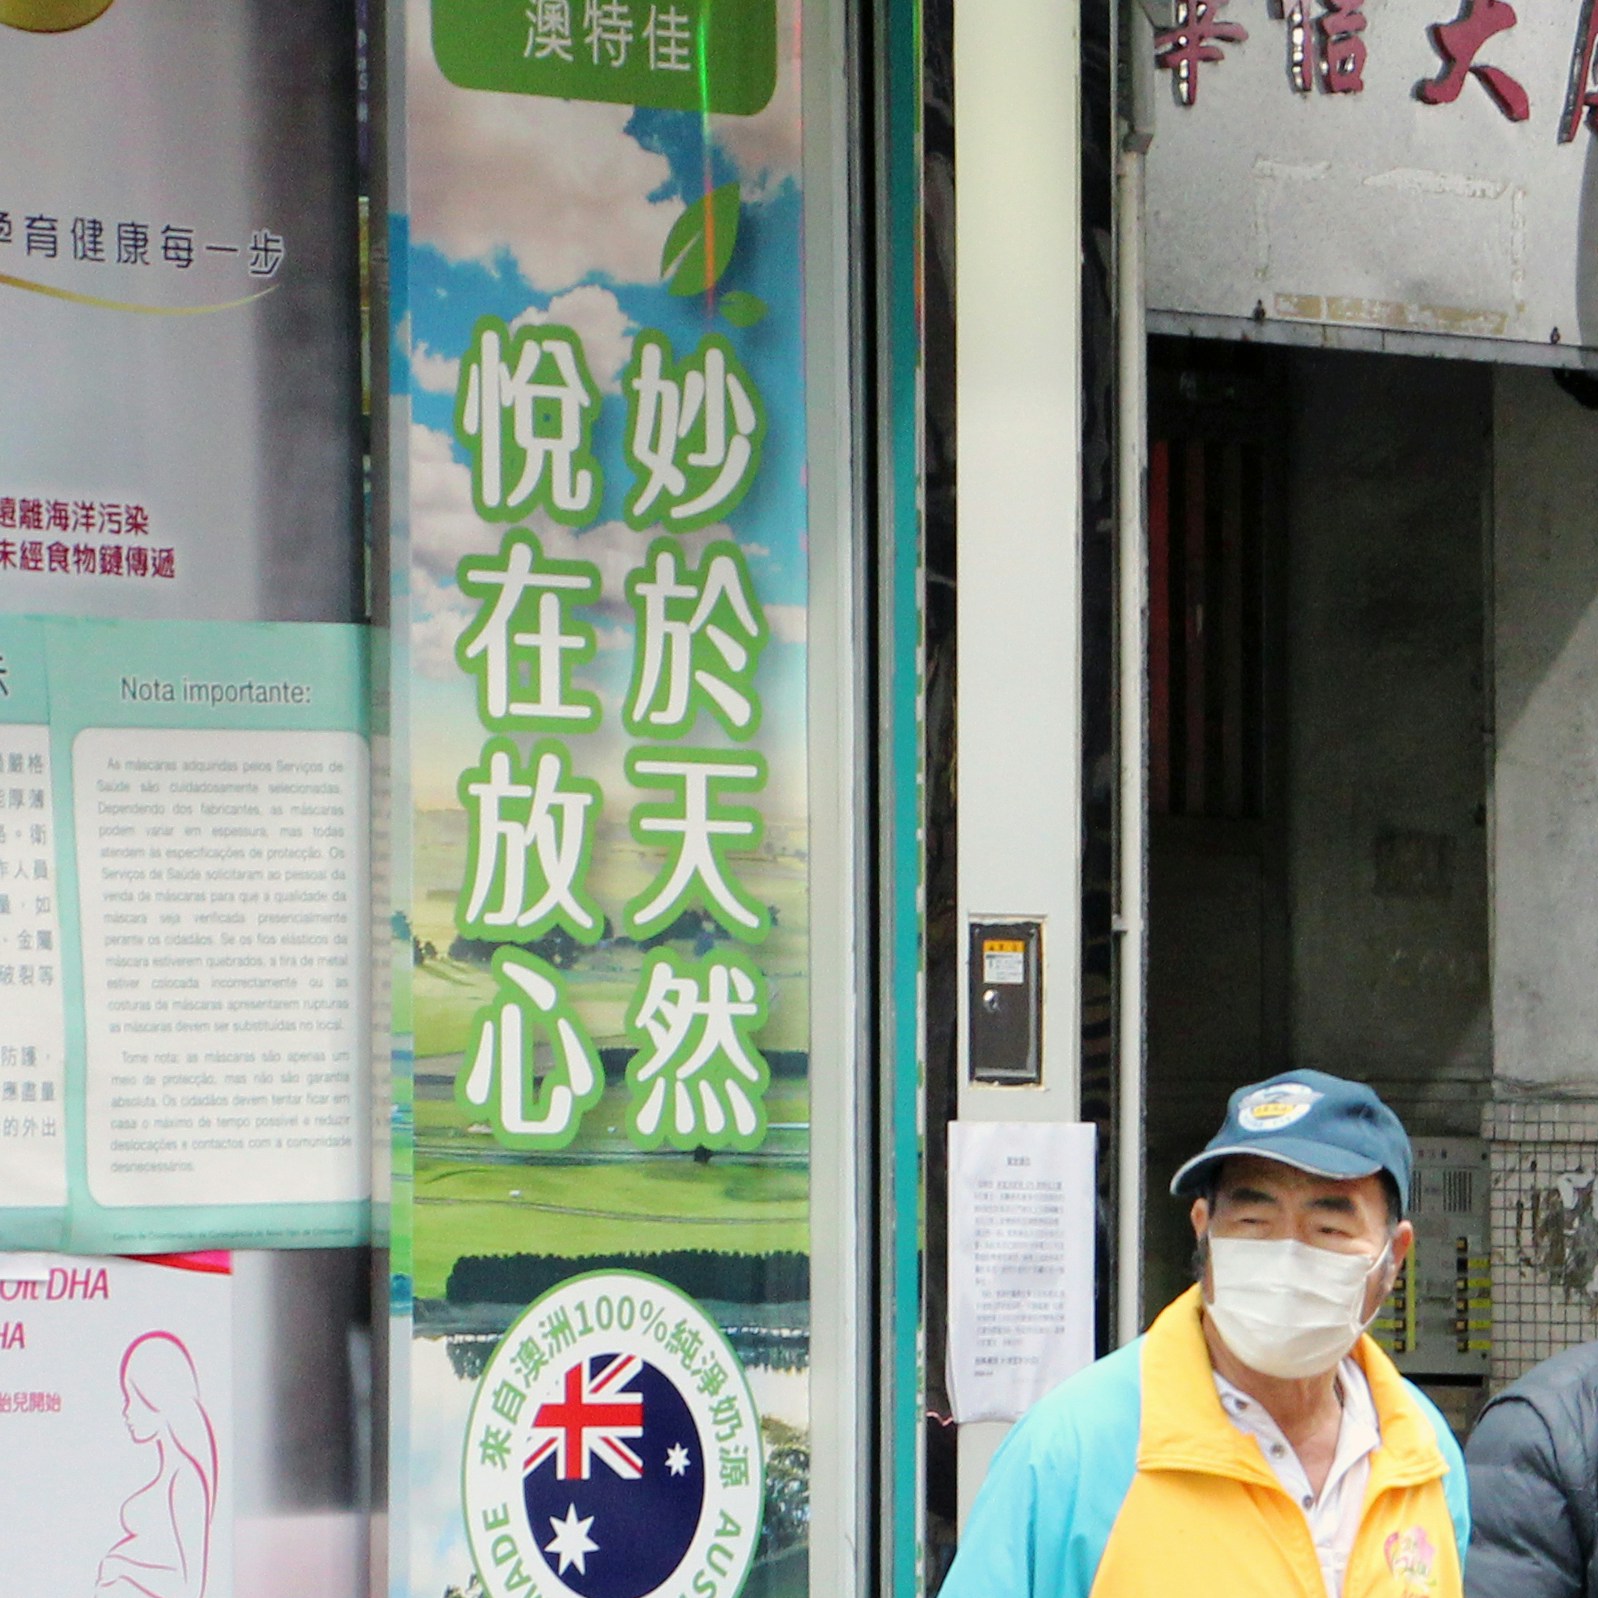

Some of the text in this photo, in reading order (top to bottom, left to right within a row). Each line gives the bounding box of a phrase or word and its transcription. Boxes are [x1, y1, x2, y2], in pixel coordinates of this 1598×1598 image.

[524, 0, 693, 74] 澳特佳
[121, 677, 312, 708] Nota importante:
[464, 329, 594, 1135] 悅在放心
[632, 344, 760, 1136] 妙於天然
[46, 1267, 109, 1300] DHA
